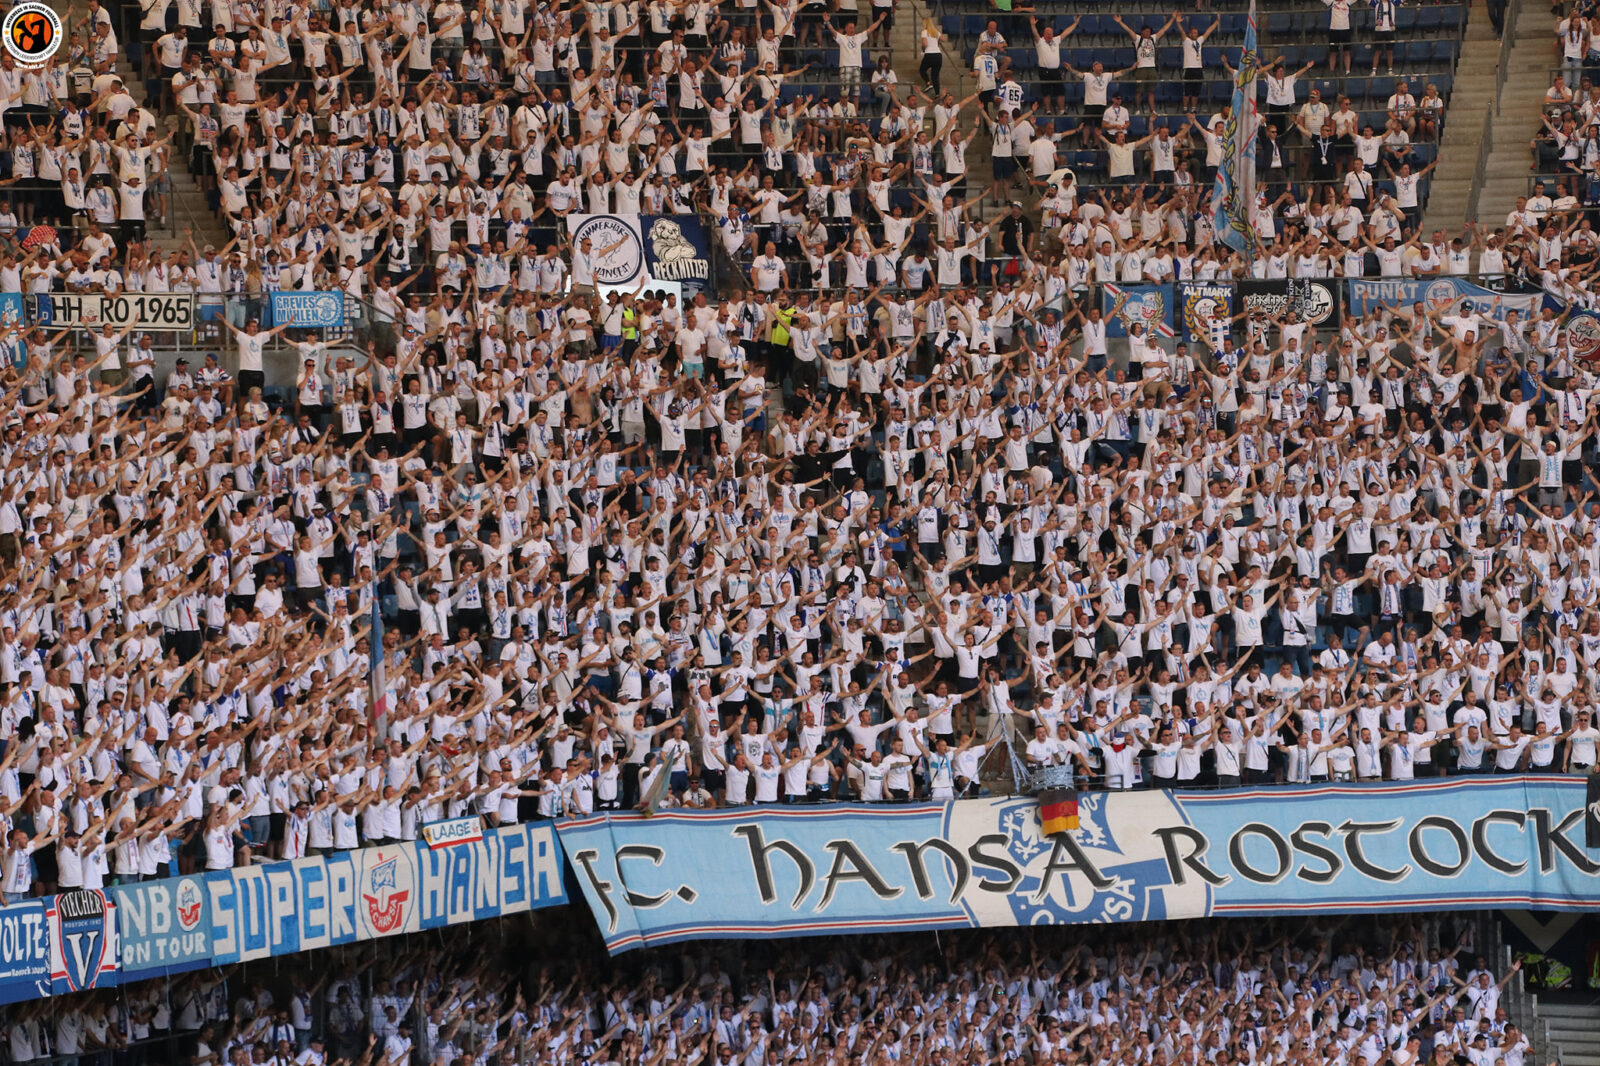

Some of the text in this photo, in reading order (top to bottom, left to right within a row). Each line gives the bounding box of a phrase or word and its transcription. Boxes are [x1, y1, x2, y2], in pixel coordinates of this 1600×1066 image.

[653, 258, 709, 281] RECKNITZER
[1183, 286, 1232, 297] ALTMARK
[1354, 283, 1419, 300] PUNKT
[52, 297, 82, 322] HH
[101, 297, 129, 322] RO
[135, 298, 190, 323] 1965
[432, 821, 471, 841] LAAGE
[1151, 807, 1600, 888] ROSTOCK
[60, 890, 102, 917] VIECHER
[207, 826, 563, 956] SUPER HANSA
[118, 886, 171, 938] NB
[0, 912, 46, 963] OLTE
[124, 940, 149, 965] ON
[156, 932, 206, 960] TOUR
